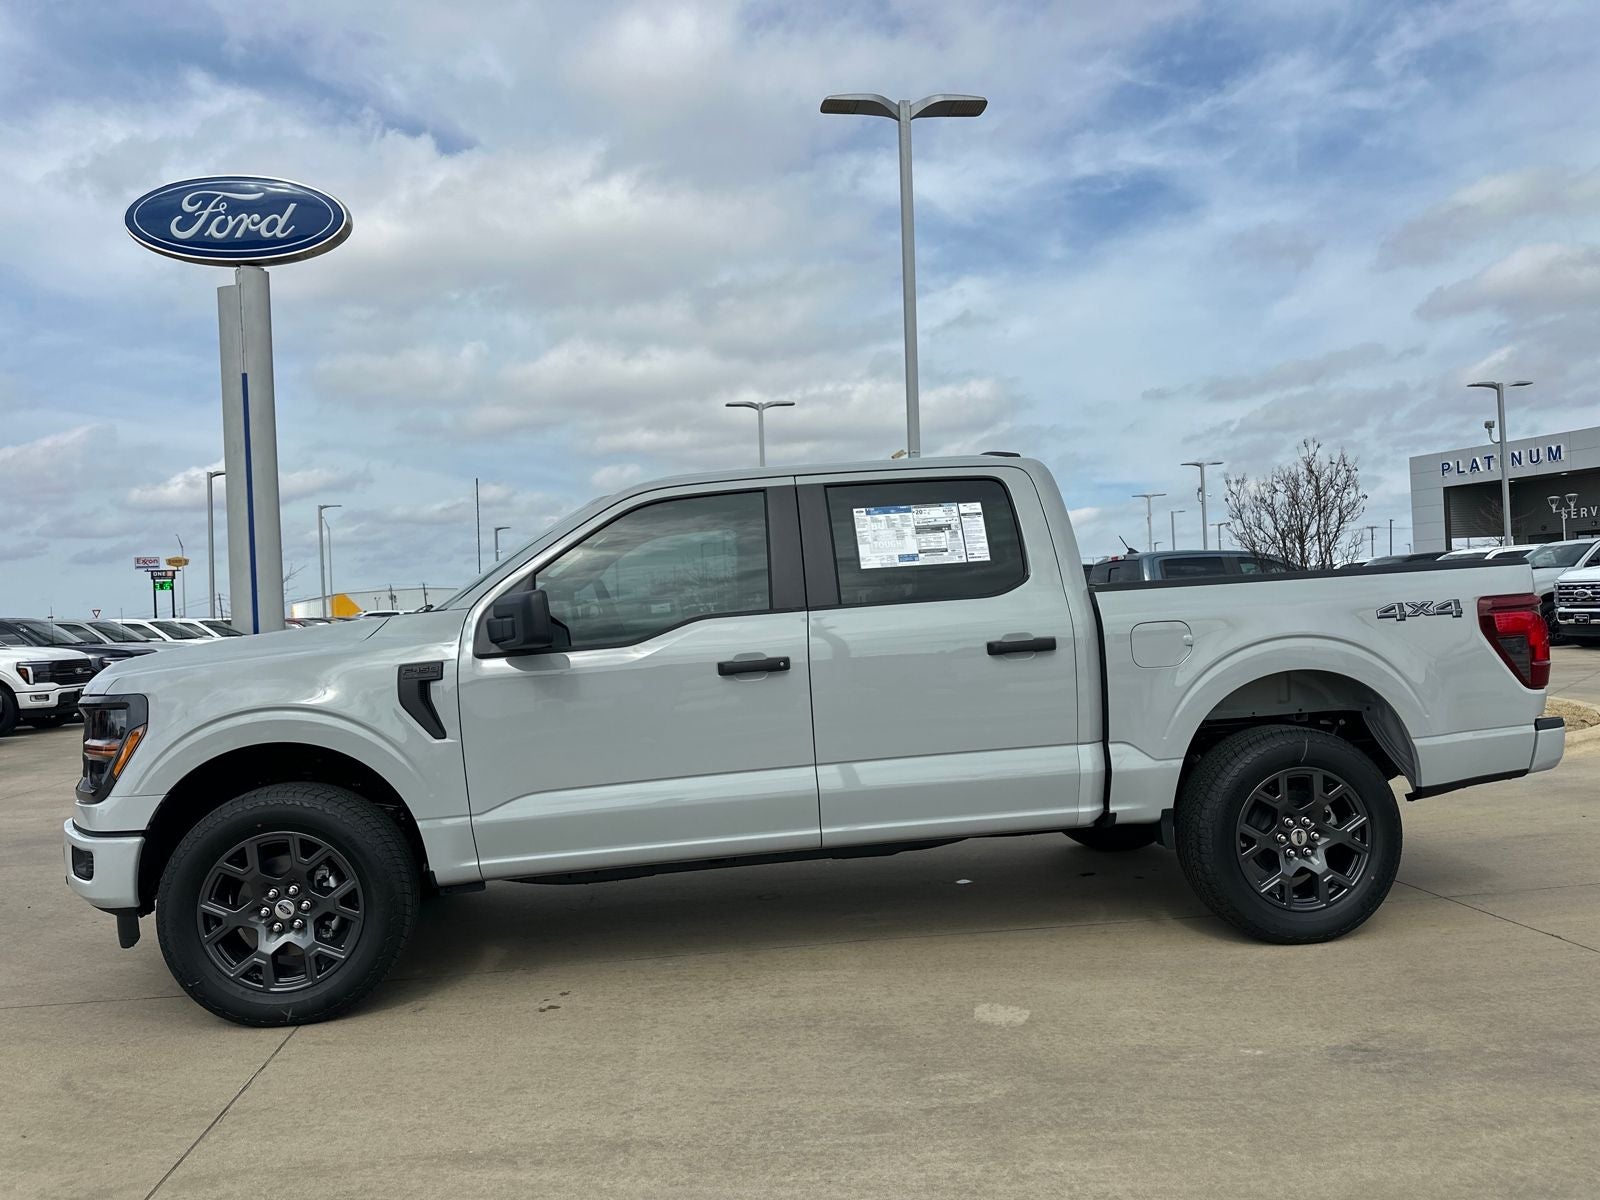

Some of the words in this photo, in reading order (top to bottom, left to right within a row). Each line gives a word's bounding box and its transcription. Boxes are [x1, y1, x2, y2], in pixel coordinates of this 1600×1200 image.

[170, 190, 297, 239] Ford
[1440, 444, 1564, 477] PLATNUM
[136, 557, 158, 566] Exxon
